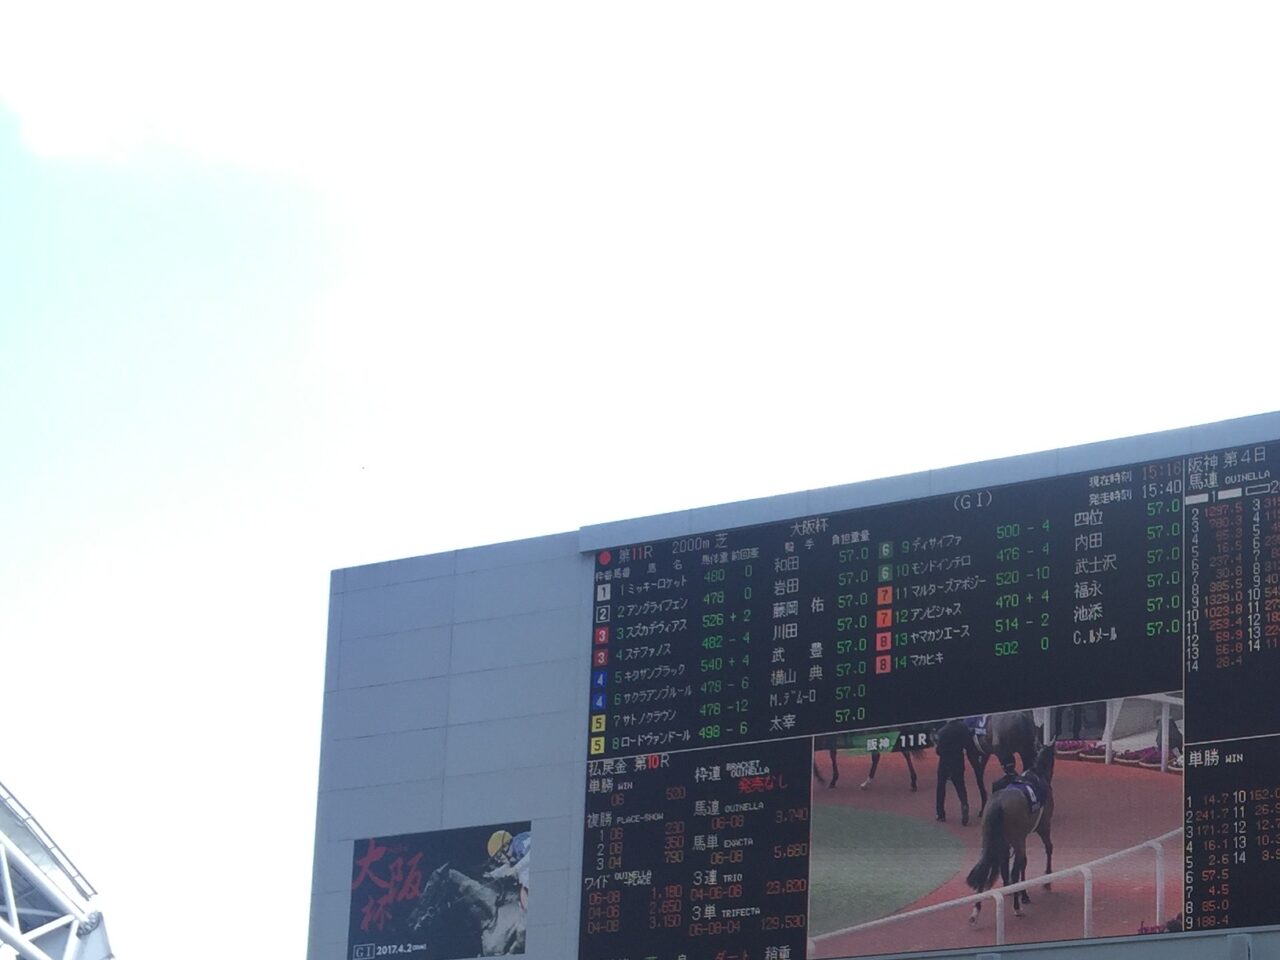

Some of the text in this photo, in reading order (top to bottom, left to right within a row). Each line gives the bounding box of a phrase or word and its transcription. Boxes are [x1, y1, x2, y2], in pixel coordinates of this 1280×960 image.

[1089, 463, 1181, 488] 現在時刻 15:16
[1188, 447, 1266, 474] 阪神 第4日
[1188, 470, 1270, 490] 馬連 QUINELLA
[1089, 480, 1182, 506] 発走時刻 15:40
[790, 518, 829, 537] 大阪杯
[902, 499, 1180, 553] 9 ディサイファ 500 四位 57.0
[618, 533, 728, 564] 第11R 2000m 芝
[897, 523, 1180, 577] 10 モンドインテロ 476 内田 57.0
[621, 584, 624, 596] 1
[628, 575, 687, 594] ミッキーロケット
[704, 569, 725, 582] 480
[774, 556, 799, 573] 和田
[839, 547, 868, 563] 57.0
[896, 547, 1180, 600] 11 マルターズアポジー 520 武士沢 57.0
[617, 570, 868, 618] 2 アングライフェン 478 岩田 57.0
[895, 571, 1180, 623] 12 アンビシャス 470 福永 57.0
[616, 593, 868, 639] 3 スズカデヴィアス 526 藤岡 佑 57.0
[895, 595, 1180, 646] 13 ヤマカツエース 514 池添 57.0
[616, 615, 868, 660] 4 ステファノス 482 川田 57.0
[895, 656, 907, 669] 14
[910, 652, 944, 667] マカヒキ
[994, 641, 1018, 656] 502
[1147, 619, 1180, 636] 57.0
[615, 672, 622, 683] 5
[700, 658, 722, 672] 540
[771, 647, 785, 663] 武
[809, 642, 823, 659] 豊
[836, 639, 867, 654] 57.0
[614, 694, 621, 705] 6
[700, 680, 722, 693] 478
[770, 668, 797, 686] 横山
[808, 664, 823, 681] 典
[836, 662, 866, 677] 57.0
[613, 715, 620, 726] 7
[622, 710, 677, 726] サトノクラウン
[699, 703, 721, 716] 478
[835, 684, 865, 700] 57.0
[612, 707, 865, 750] 8 ロードヴァンドール 498 太宰 57.0
[867, 733, 927, 751] 阪神 11R
[634, 753, 670, 772] 第10R
[1188, 748, 1243, 768] 単勝 WIN
[588, 777, 614, 794] 単勝
[723, 874, 743, 883] TRIO
[722, 907, 761, 918] TRIFECTA
